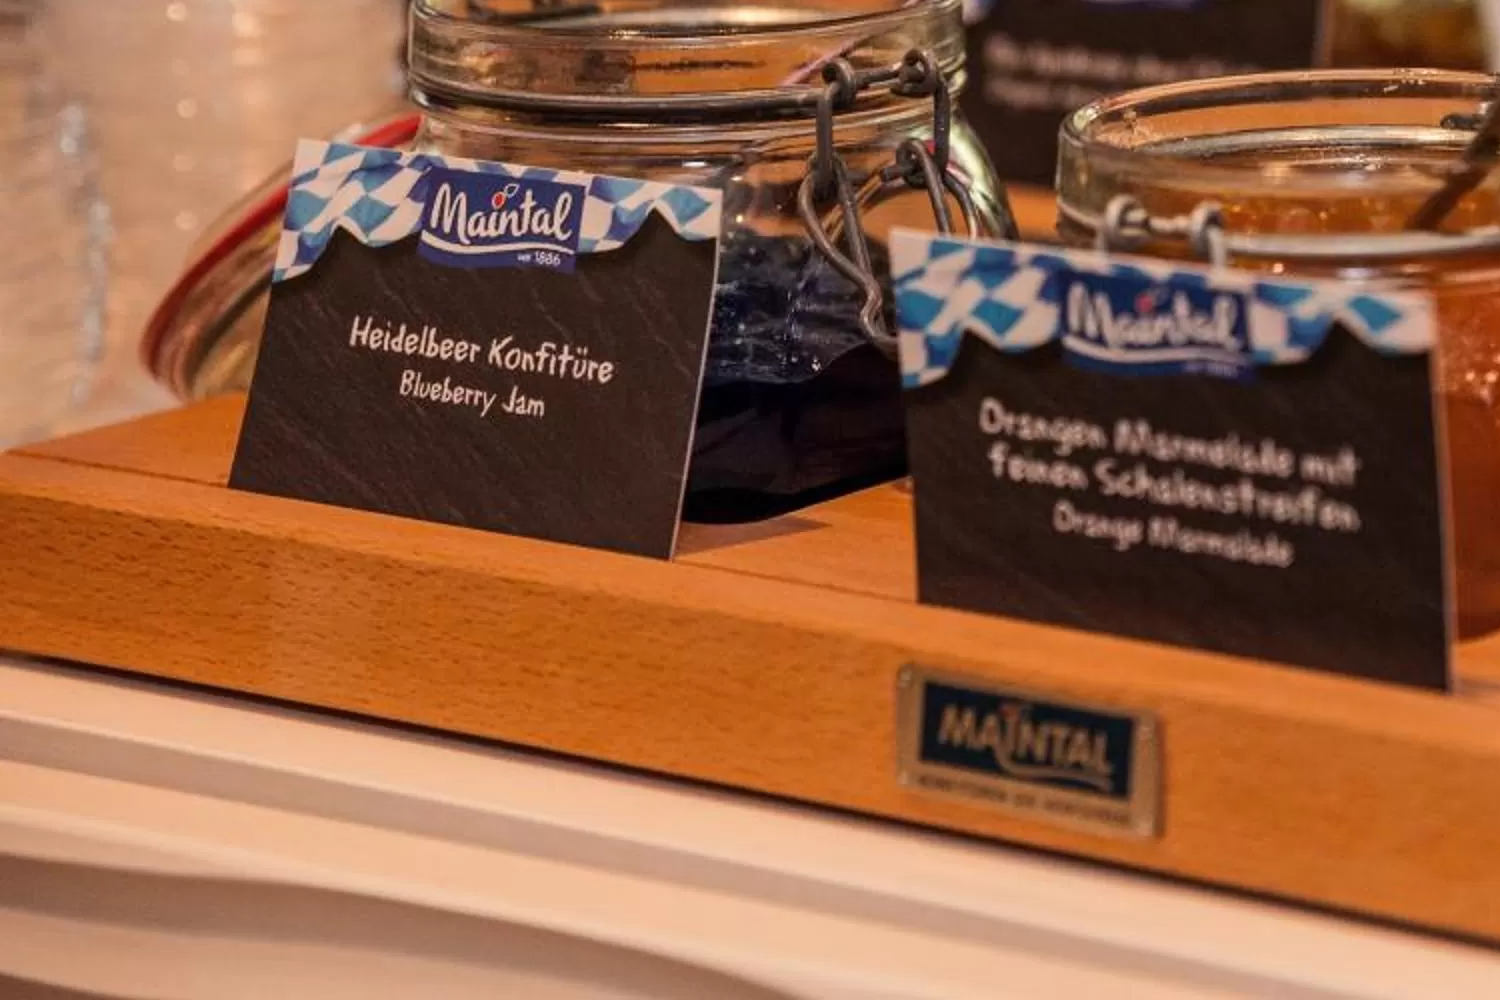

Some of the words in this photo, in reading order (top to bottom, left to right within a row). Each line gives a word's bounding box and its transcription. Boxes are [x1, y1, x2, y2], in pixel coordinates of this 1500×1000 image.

[429, 182, 573, 245] Maintal
[535, 251, 561, 266] 1886
[350, 315, 481, 363] Heidelbeer
[488, 336, 615, 384] Konfitüre
[1066, 280, 1243, 350] Maintal
[400, 369, 497, 418] Blueberry
[501, 385, 545, 418] Jam
[979, 396, 1107, 457] Orangen
[1301, 442, 1361, 486] mit
[988, 438, 1089, 490] feinen
[1094, 457, 1361, 534] Schalenstreifen
[1053, 499, 1144, 551] Orange
[937, 702, 1115, 776] MAINTAL
